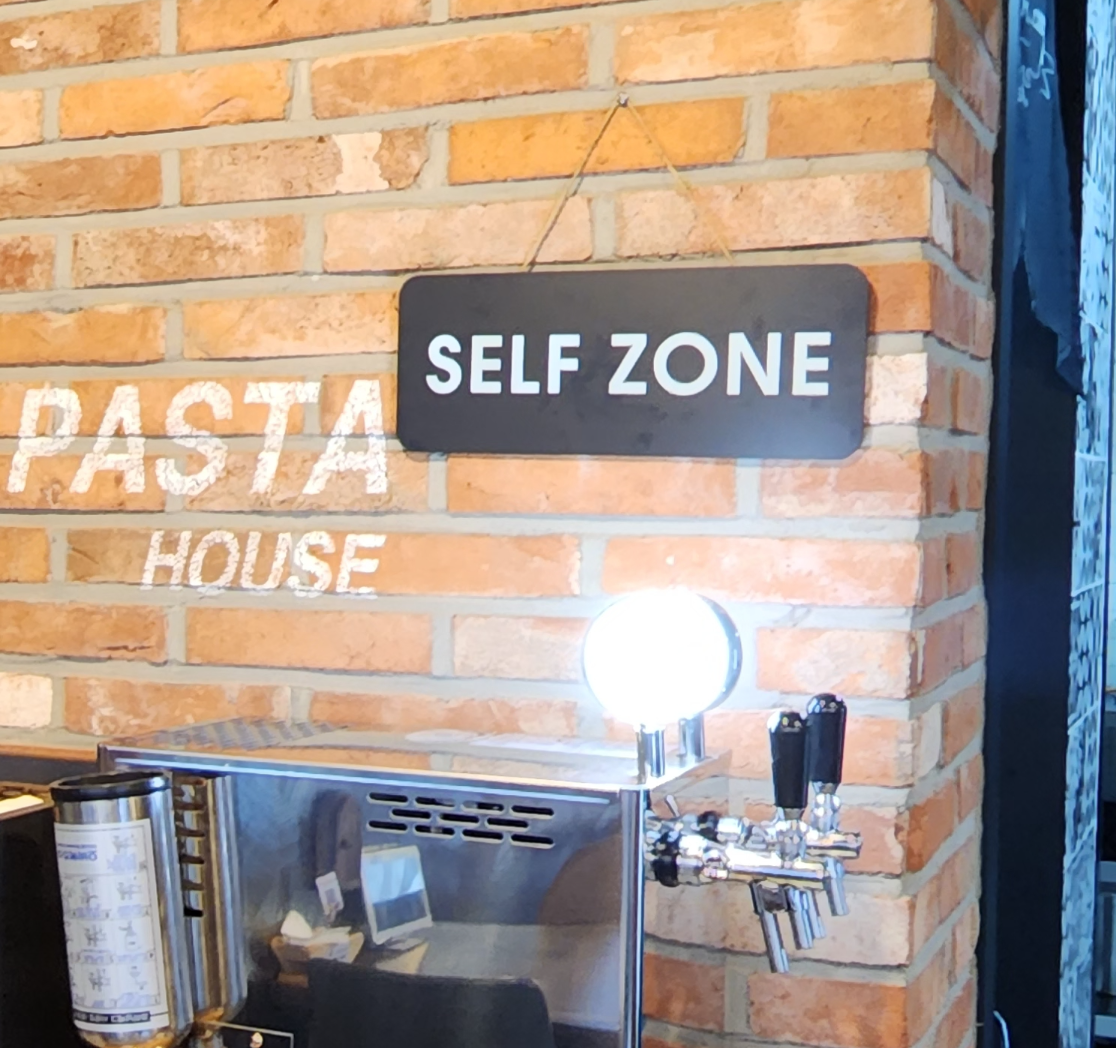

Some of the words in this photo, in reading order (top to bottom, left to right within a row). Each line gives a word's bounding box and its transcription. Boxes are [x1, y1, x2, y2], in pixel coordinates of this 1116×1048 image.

[425, 333, 580, 395] SELF
[608, 331, 832, 396] ZONE
[7, 379, 387, 495] PASTA
[140, 529, 387, 598] HOUSE
